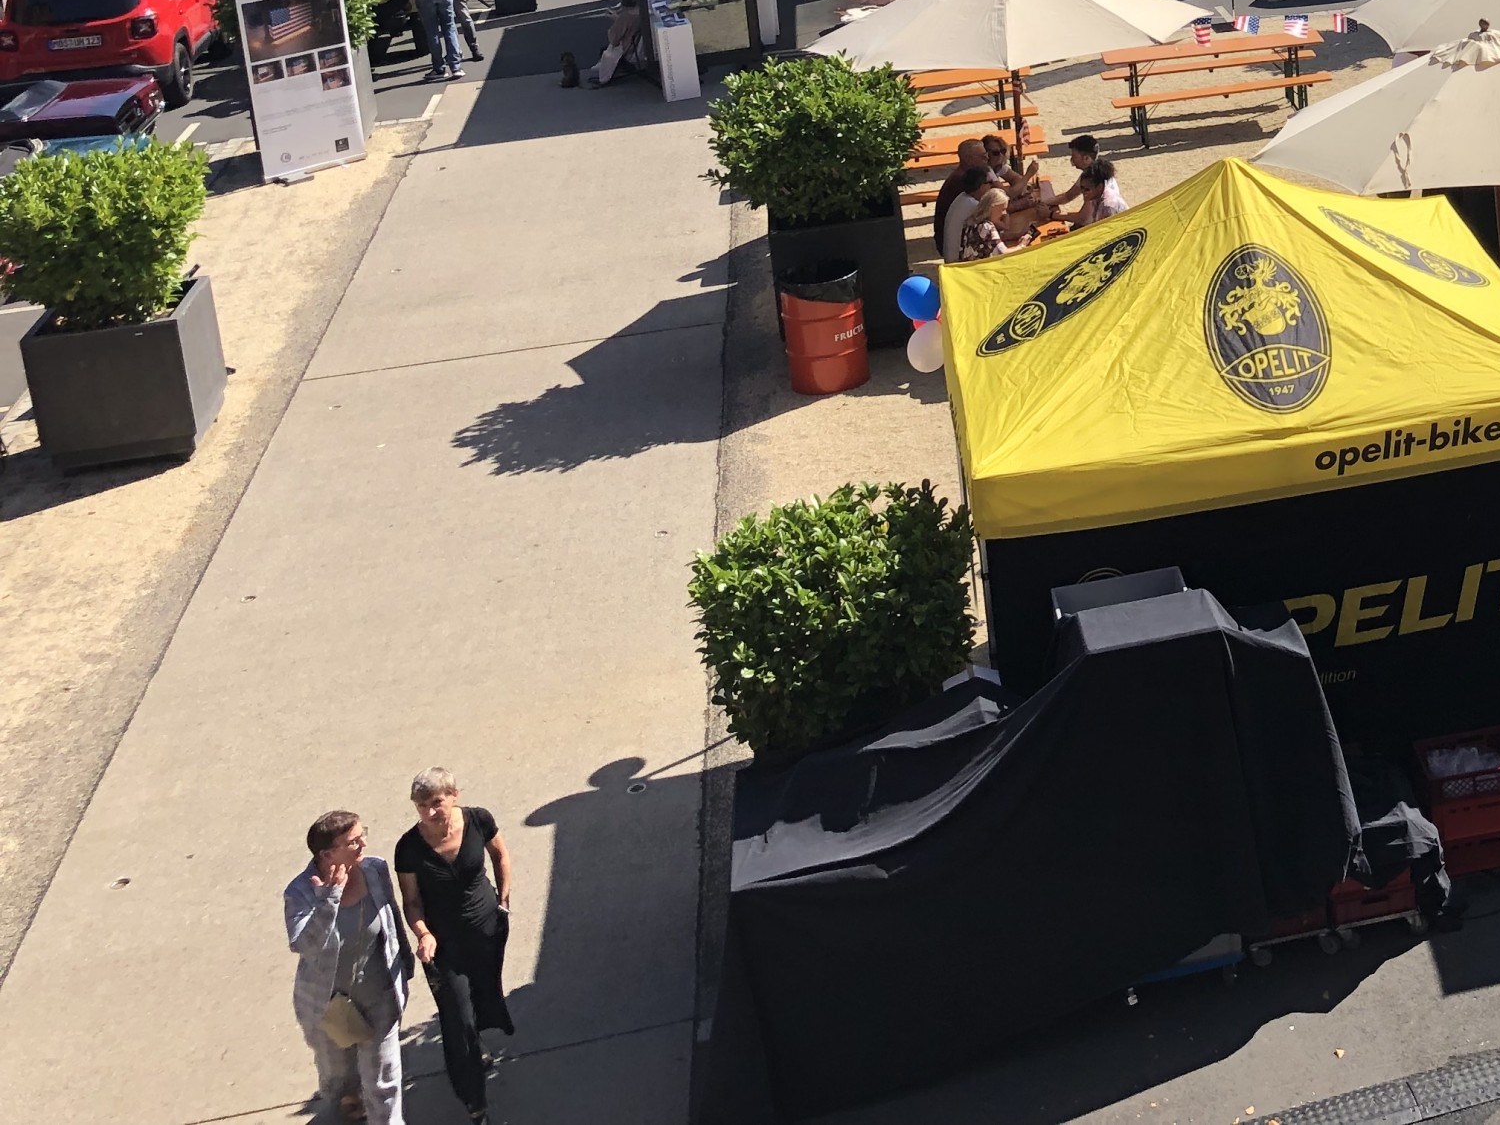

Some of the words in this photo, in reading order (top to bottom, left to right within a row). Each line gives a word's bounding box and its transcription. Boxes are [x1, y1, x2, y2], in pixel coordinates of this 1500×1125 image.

[1237, 349, 1312, 378] OPELIT
[1269, 384, 1295, 396] 1947
[1319, 669, 1357, 685] ition
